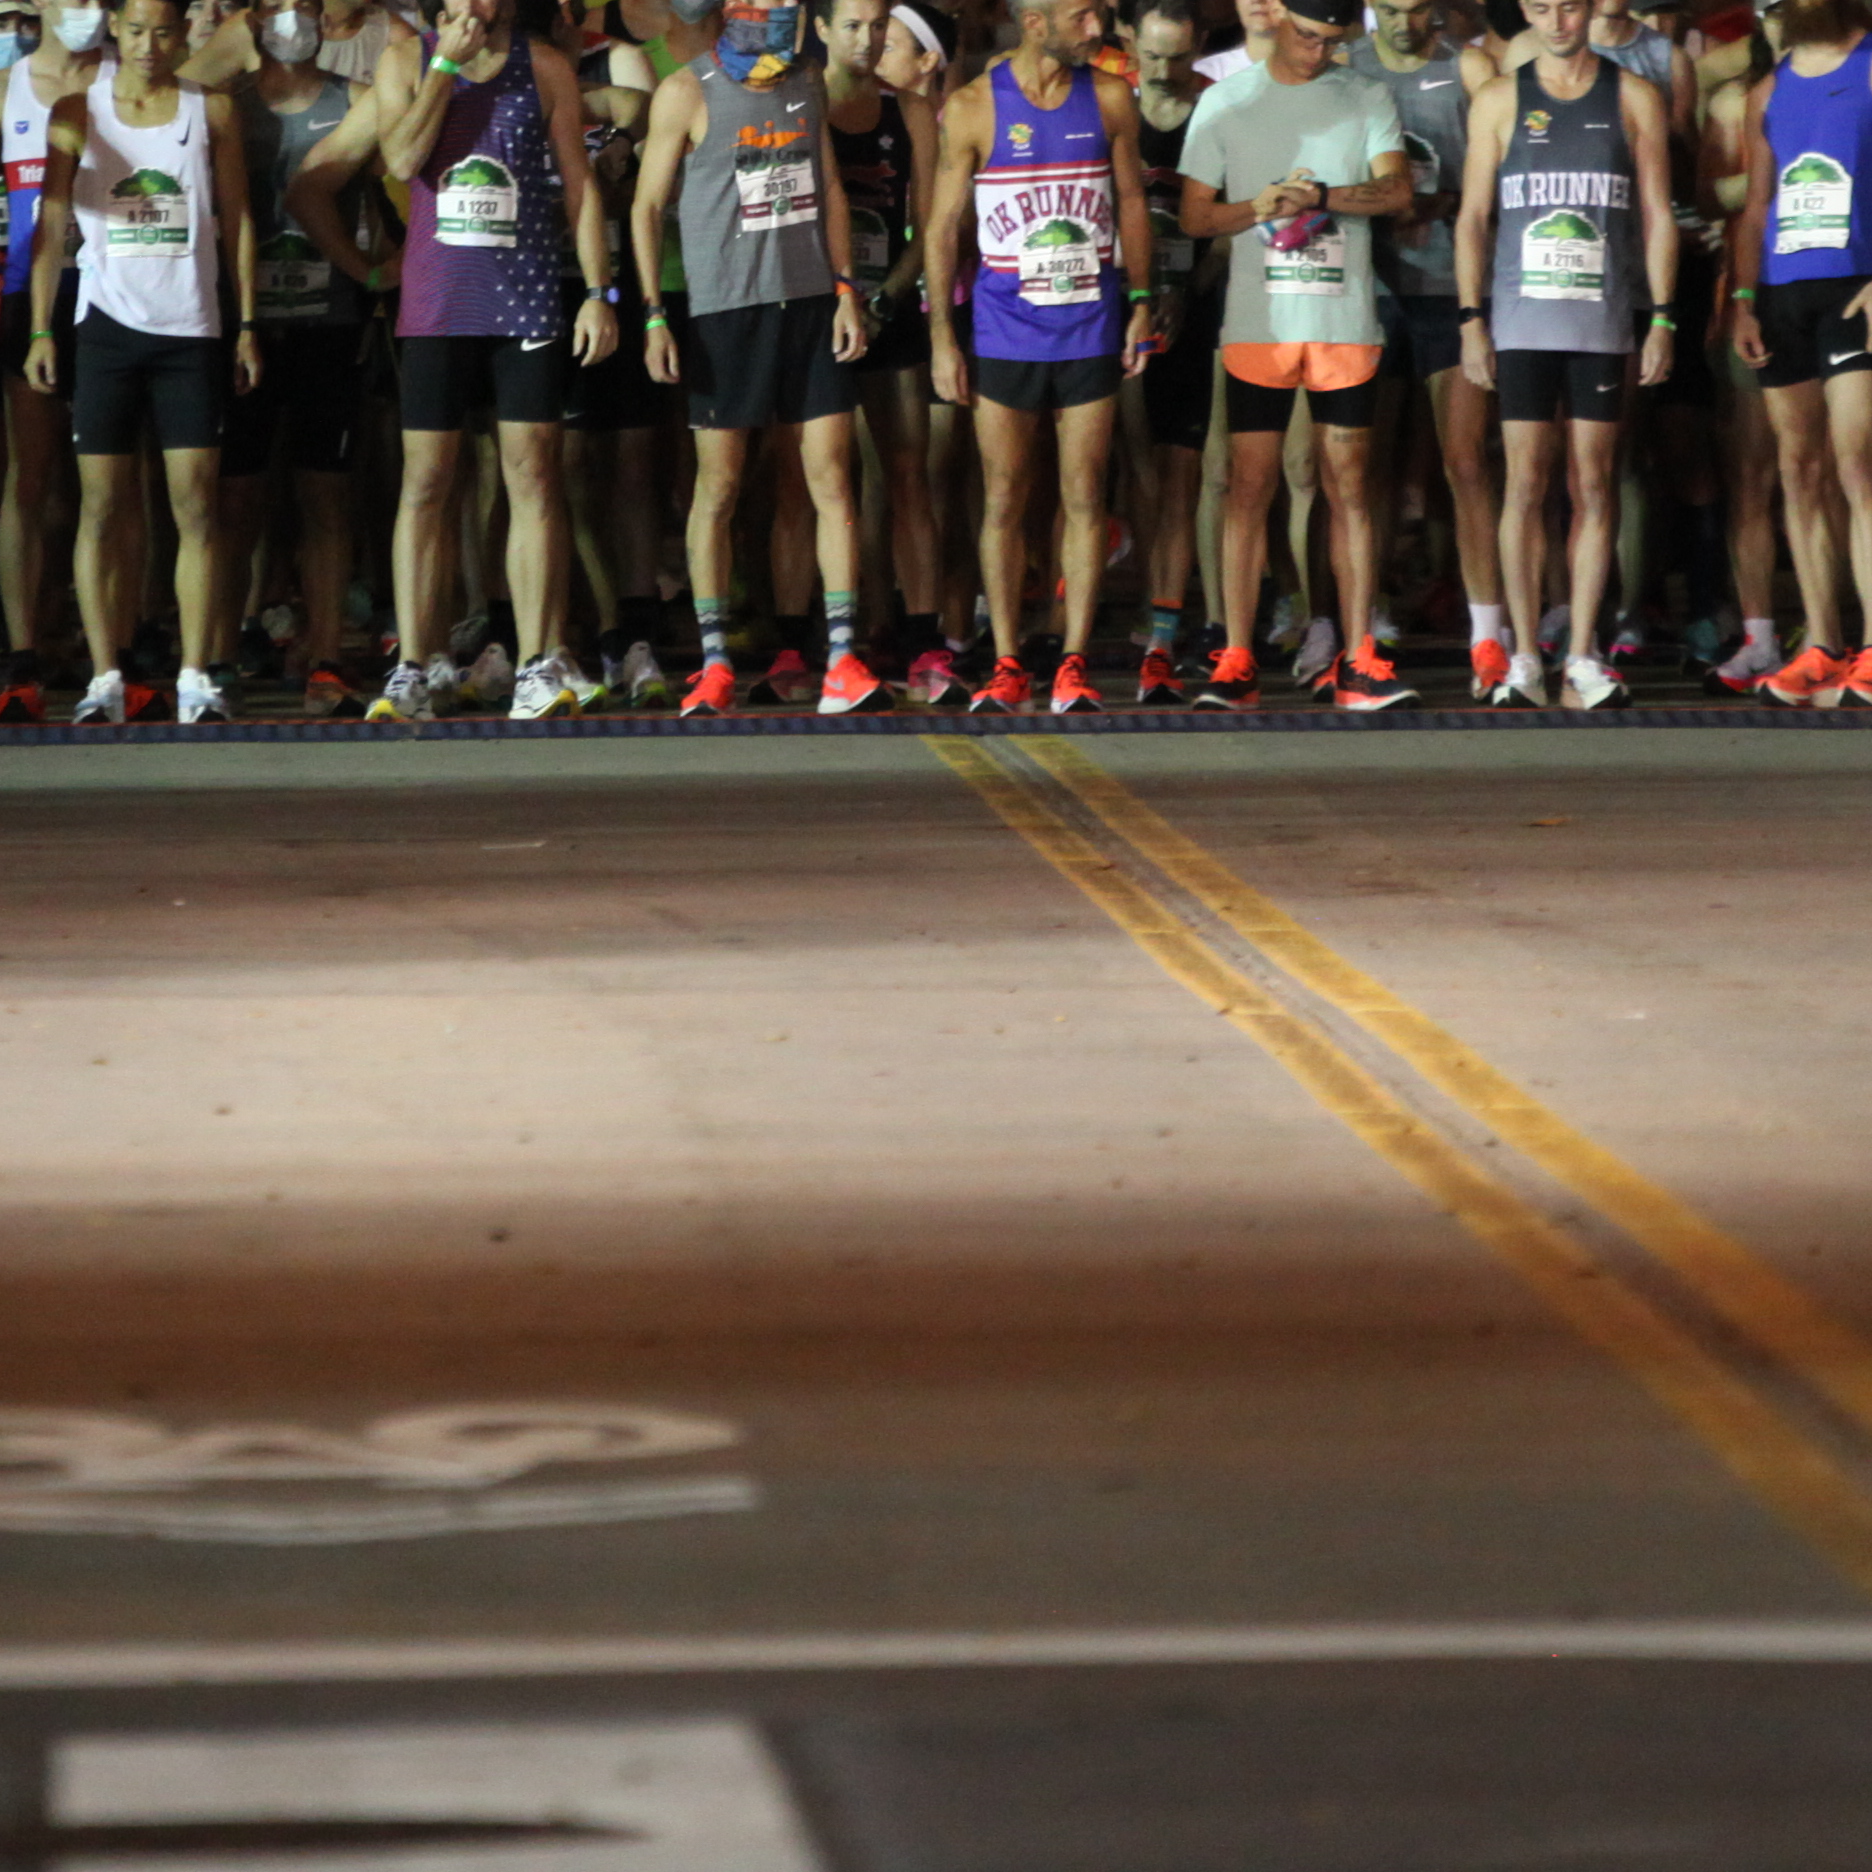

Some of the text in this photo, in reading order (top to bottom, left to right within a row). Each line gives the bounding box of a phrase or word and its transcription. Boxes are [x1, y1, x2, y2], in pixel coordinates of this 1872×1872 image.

[1501, 174, 1526, 210] OK
[457, 201, 498, 215] A 1237
[986, 200, 1019, 244] OK
[1543, 253, 1552, 266] A
